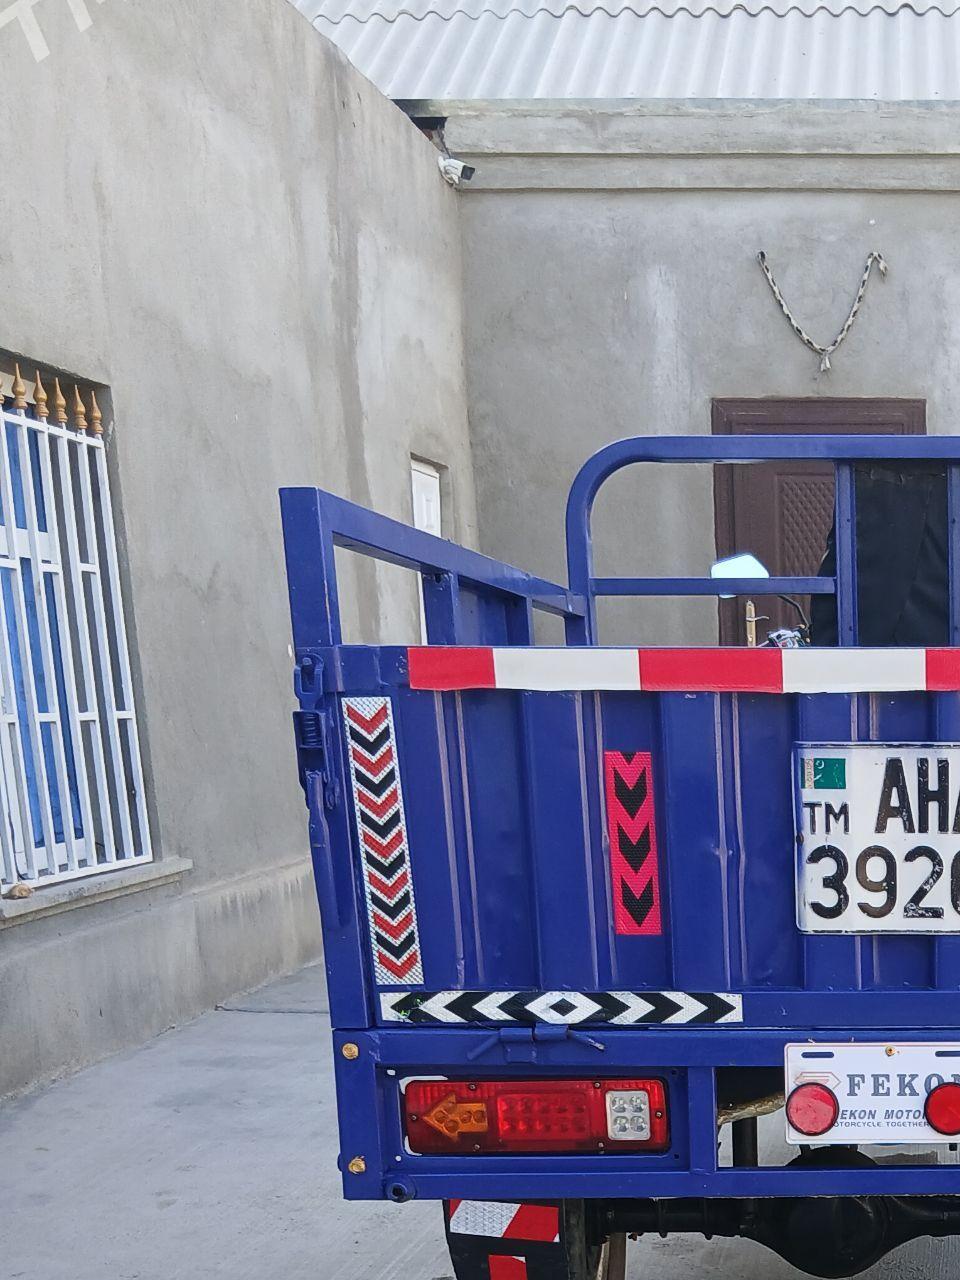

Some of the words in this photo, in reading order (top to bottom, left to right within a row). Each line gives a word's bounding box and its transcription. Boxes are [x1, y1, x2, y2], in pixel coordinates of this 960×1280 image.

[802, 801, 849, 834] TM
[840, 1109, 877, 1120] EKON
[883, 1109, 925, 1120] MOTO
